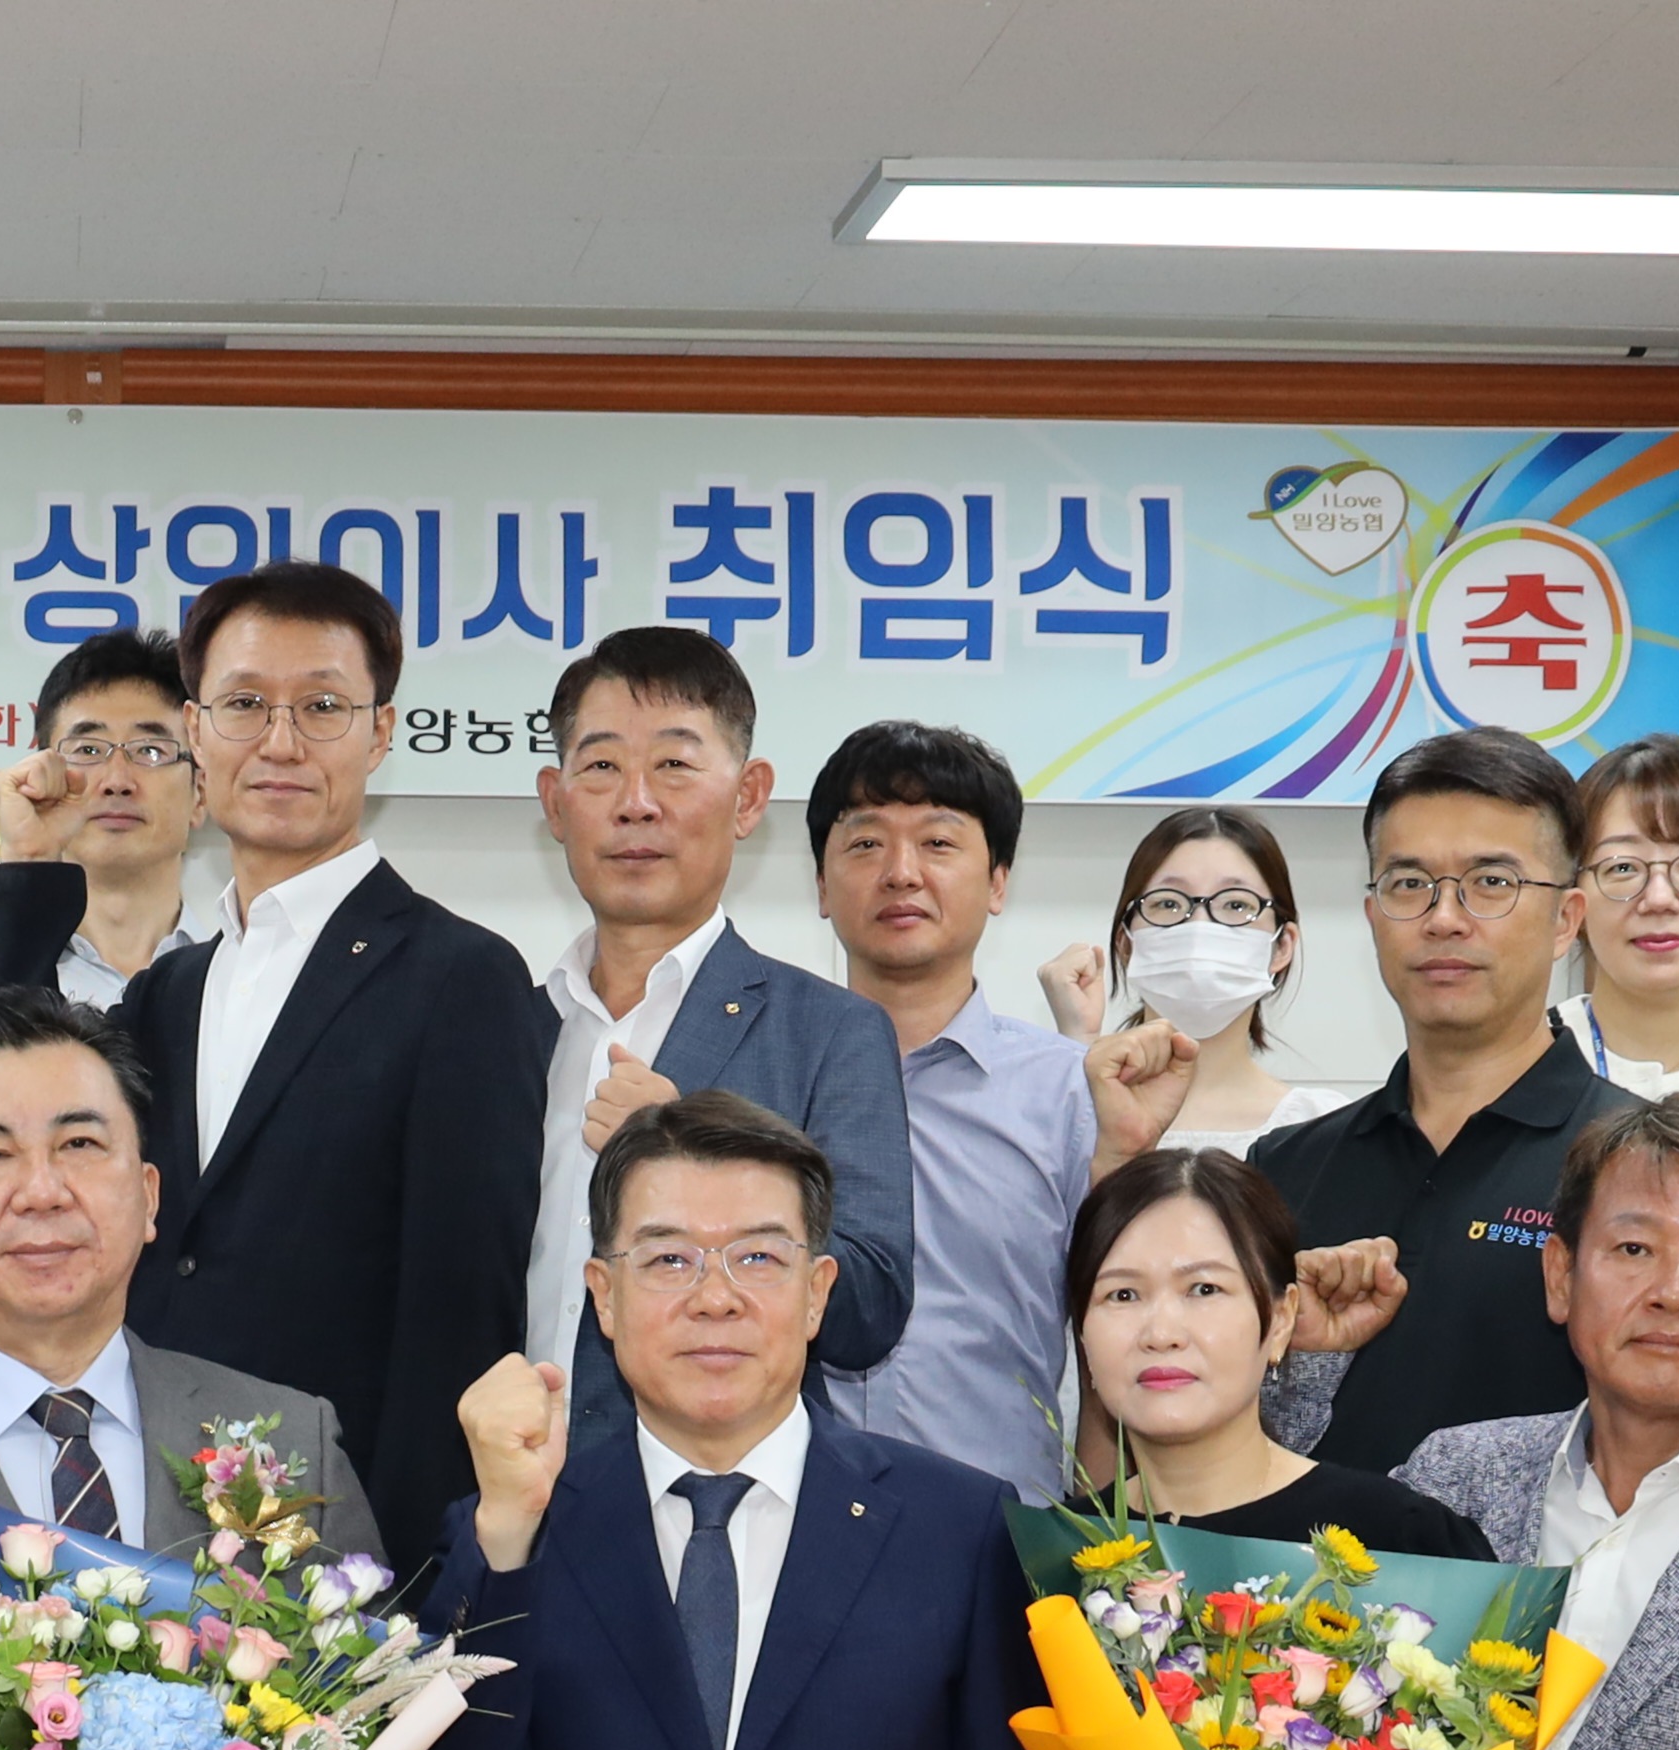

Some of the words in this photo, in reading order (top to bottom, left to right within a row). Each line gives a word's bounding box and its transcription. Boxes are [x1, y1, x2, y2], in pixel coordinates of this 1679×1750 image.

[1322, 493, 1328, 507] I
[1333, 493, 1382, 508] Love
[1293, 513, 1383, 532] 밀양농협
[665, 486, 1172, 666] 취임식
[1463, 573, 1587, 690] 축
[1504, 1206, 1513, 1221] I
